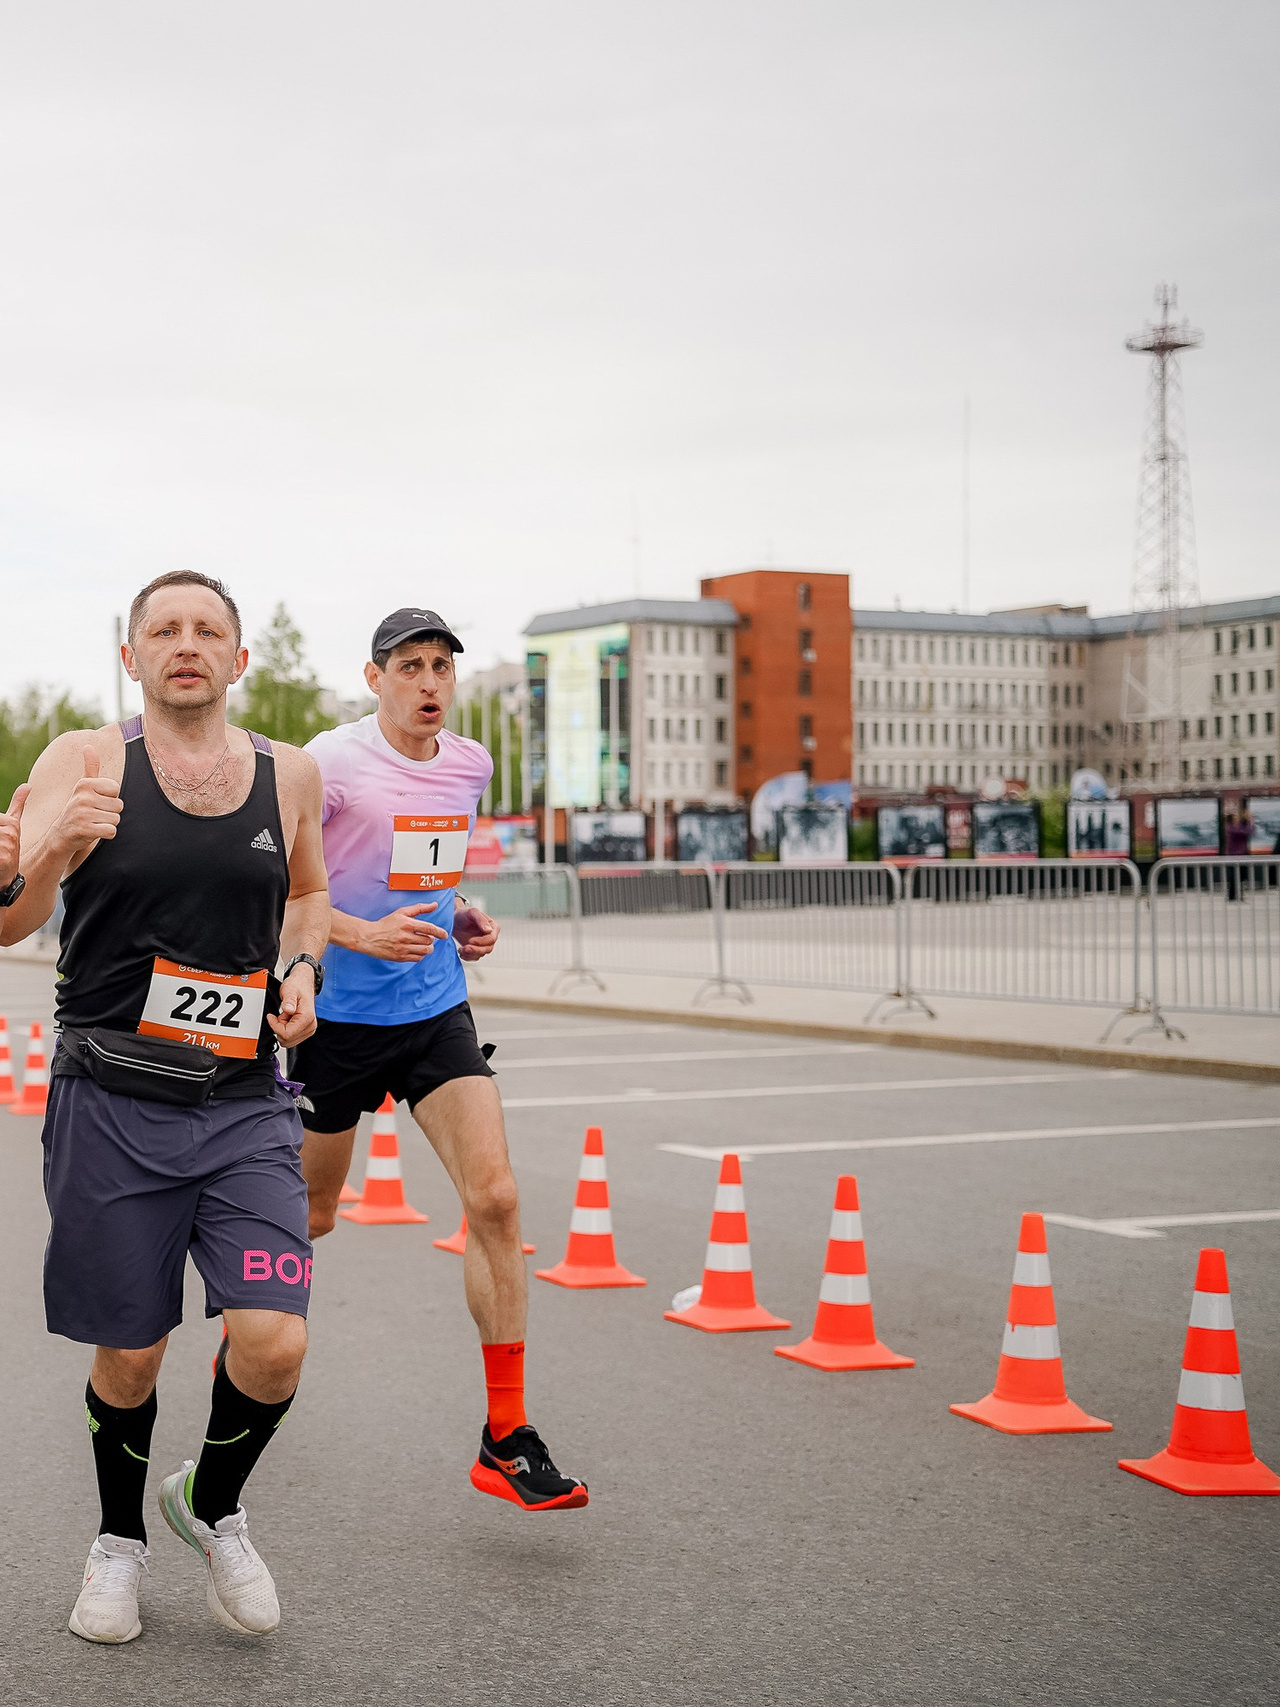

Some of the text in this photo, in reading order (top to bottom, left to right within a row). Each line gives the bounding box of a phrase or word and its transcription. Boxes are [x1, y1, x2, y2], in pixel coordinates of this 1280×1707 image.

[250, 840, 278, 853] adidas
[428, 838, 440, 867] 1
[170, 986, 244, 1029] 222
